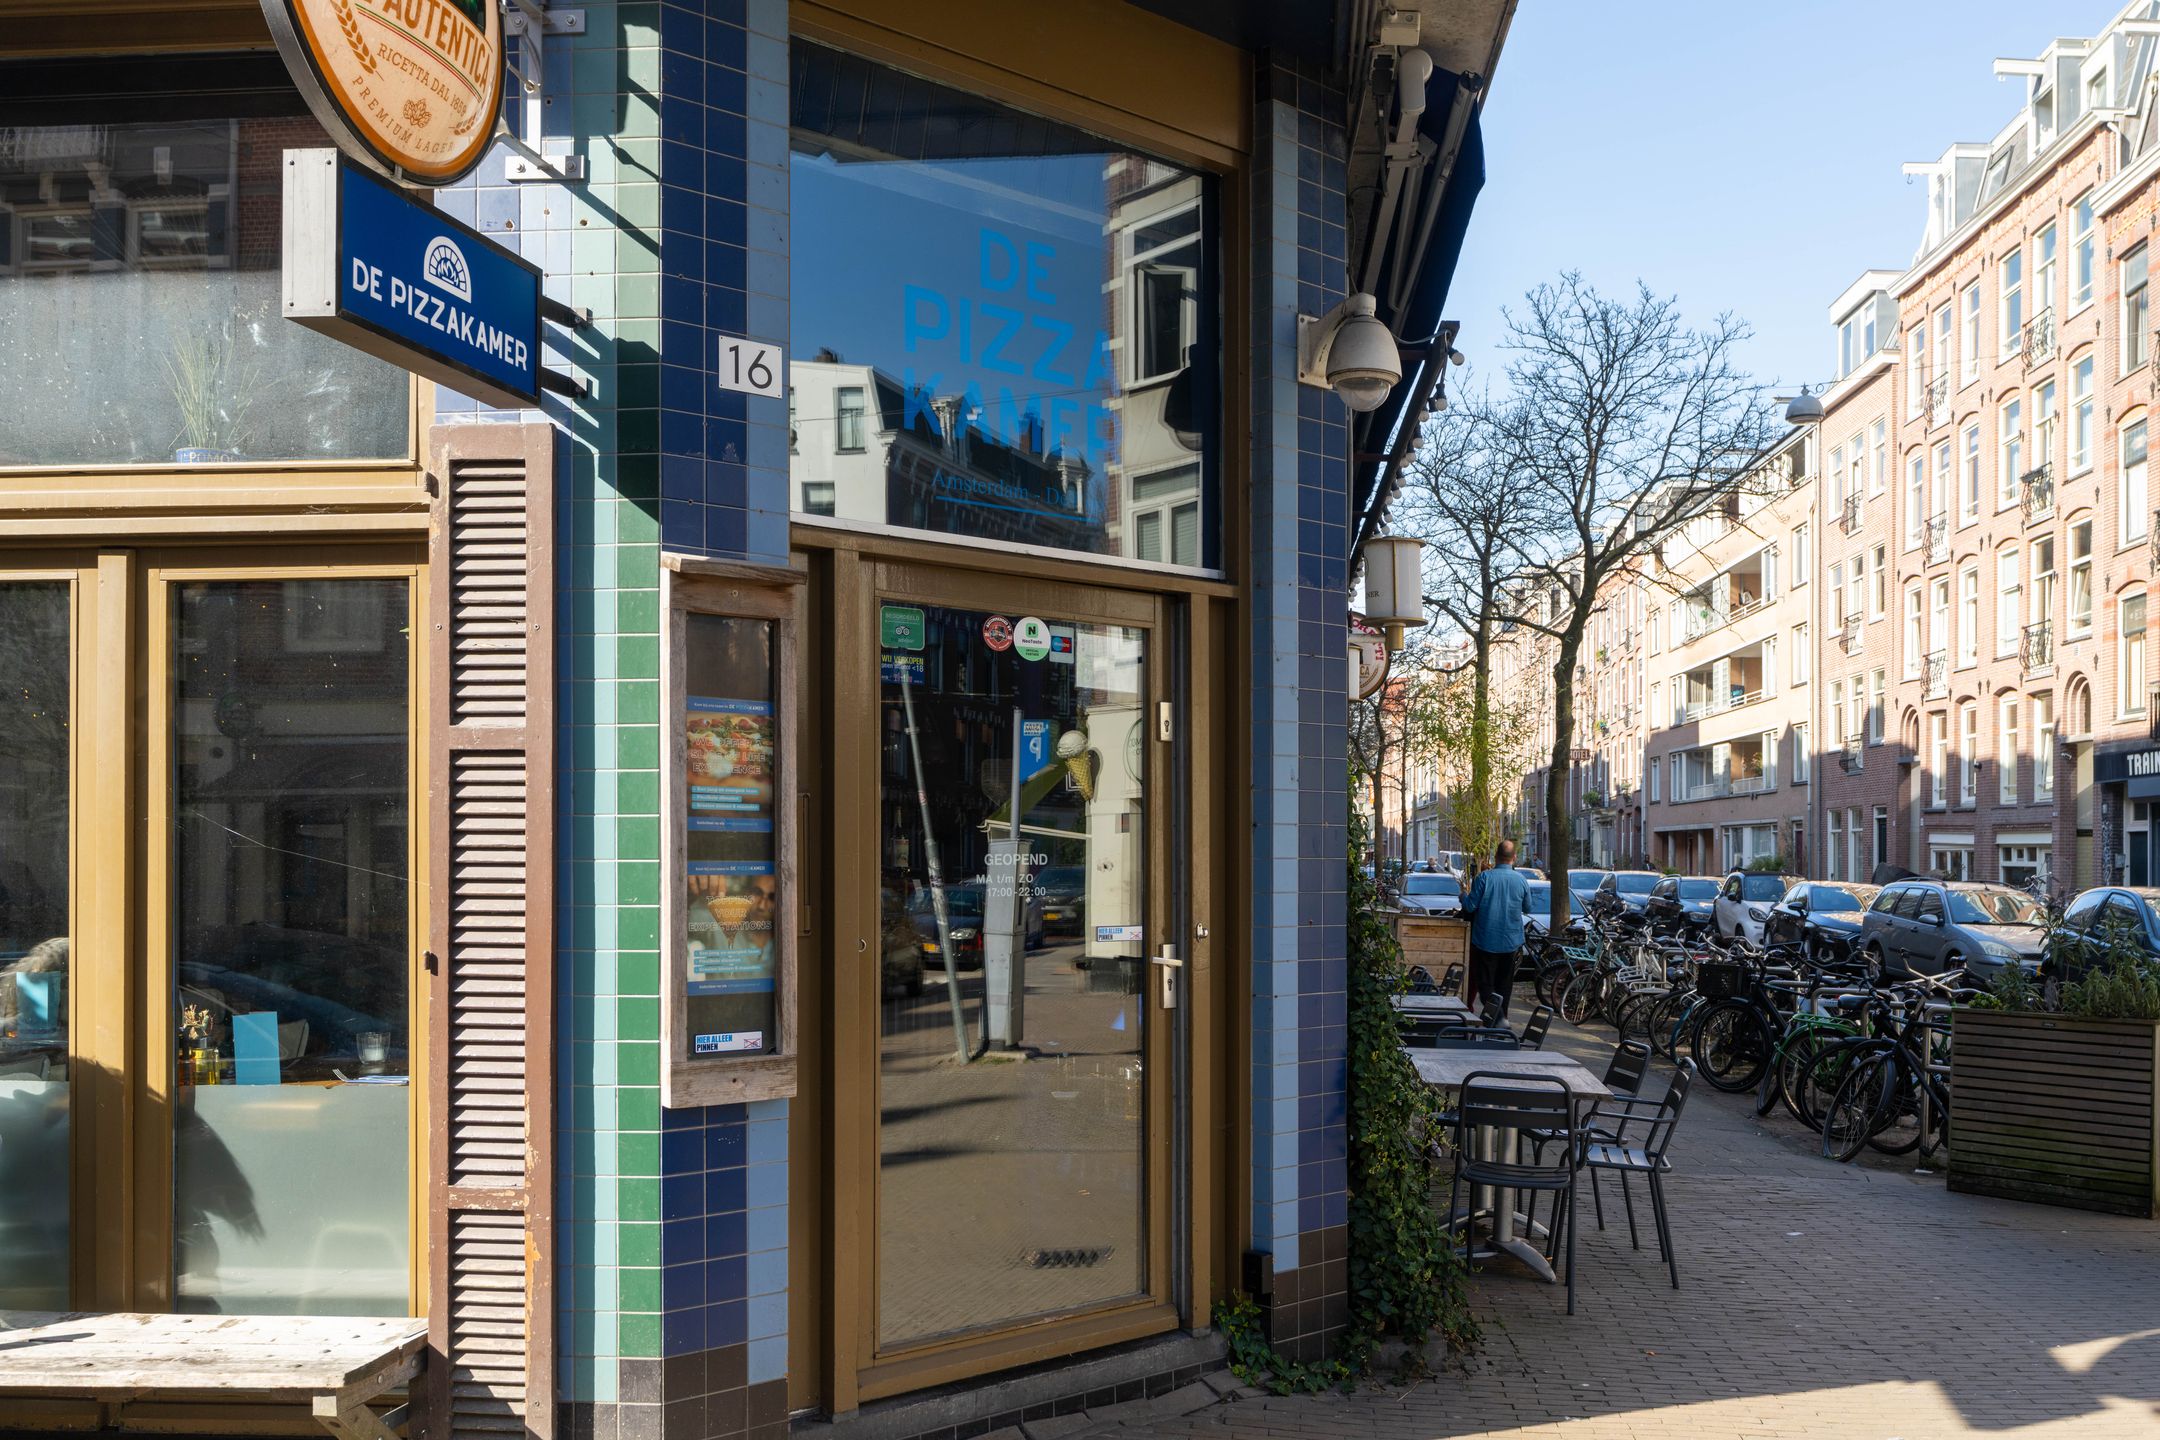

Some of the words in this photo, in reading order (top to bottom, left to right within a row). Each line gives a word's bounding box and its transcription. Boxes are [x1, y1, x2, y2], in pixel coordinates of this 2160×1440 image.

[366, 0, 491, 93] AUTENTICA
[377, 43, 429, 87] RICETTA
[430, 77, 451, 102] DAL
[450, 94, 467, 118] 1859
[352, 75, 413, 144] PREMIUM
[415, 137, 454, 154] LAGER
[979, 226, 1056, 306] DE
[352, 256, 383, 302] DE
[391, 276, 527, 371] PIZZAKAMER
[903, 283, 1120, 397] PIZZA
[729, 344, 773, 390] 16
[931, 468, 1029, 500] Amsterdam
[976, 874, 993, 884] MA
[997, 874, 1014, 884] t/m
[1019, 873, 1034, 883] ZO
[984, 853, 1048, 866] GEOPEND
[688, 920, 773, 932] EXPECTATIONS
[696, 1036, 710, 1044] HIER
[711, 1034, 733, 1043] ALLEEN
[696, 1043, 719, 1052] PINNEN
